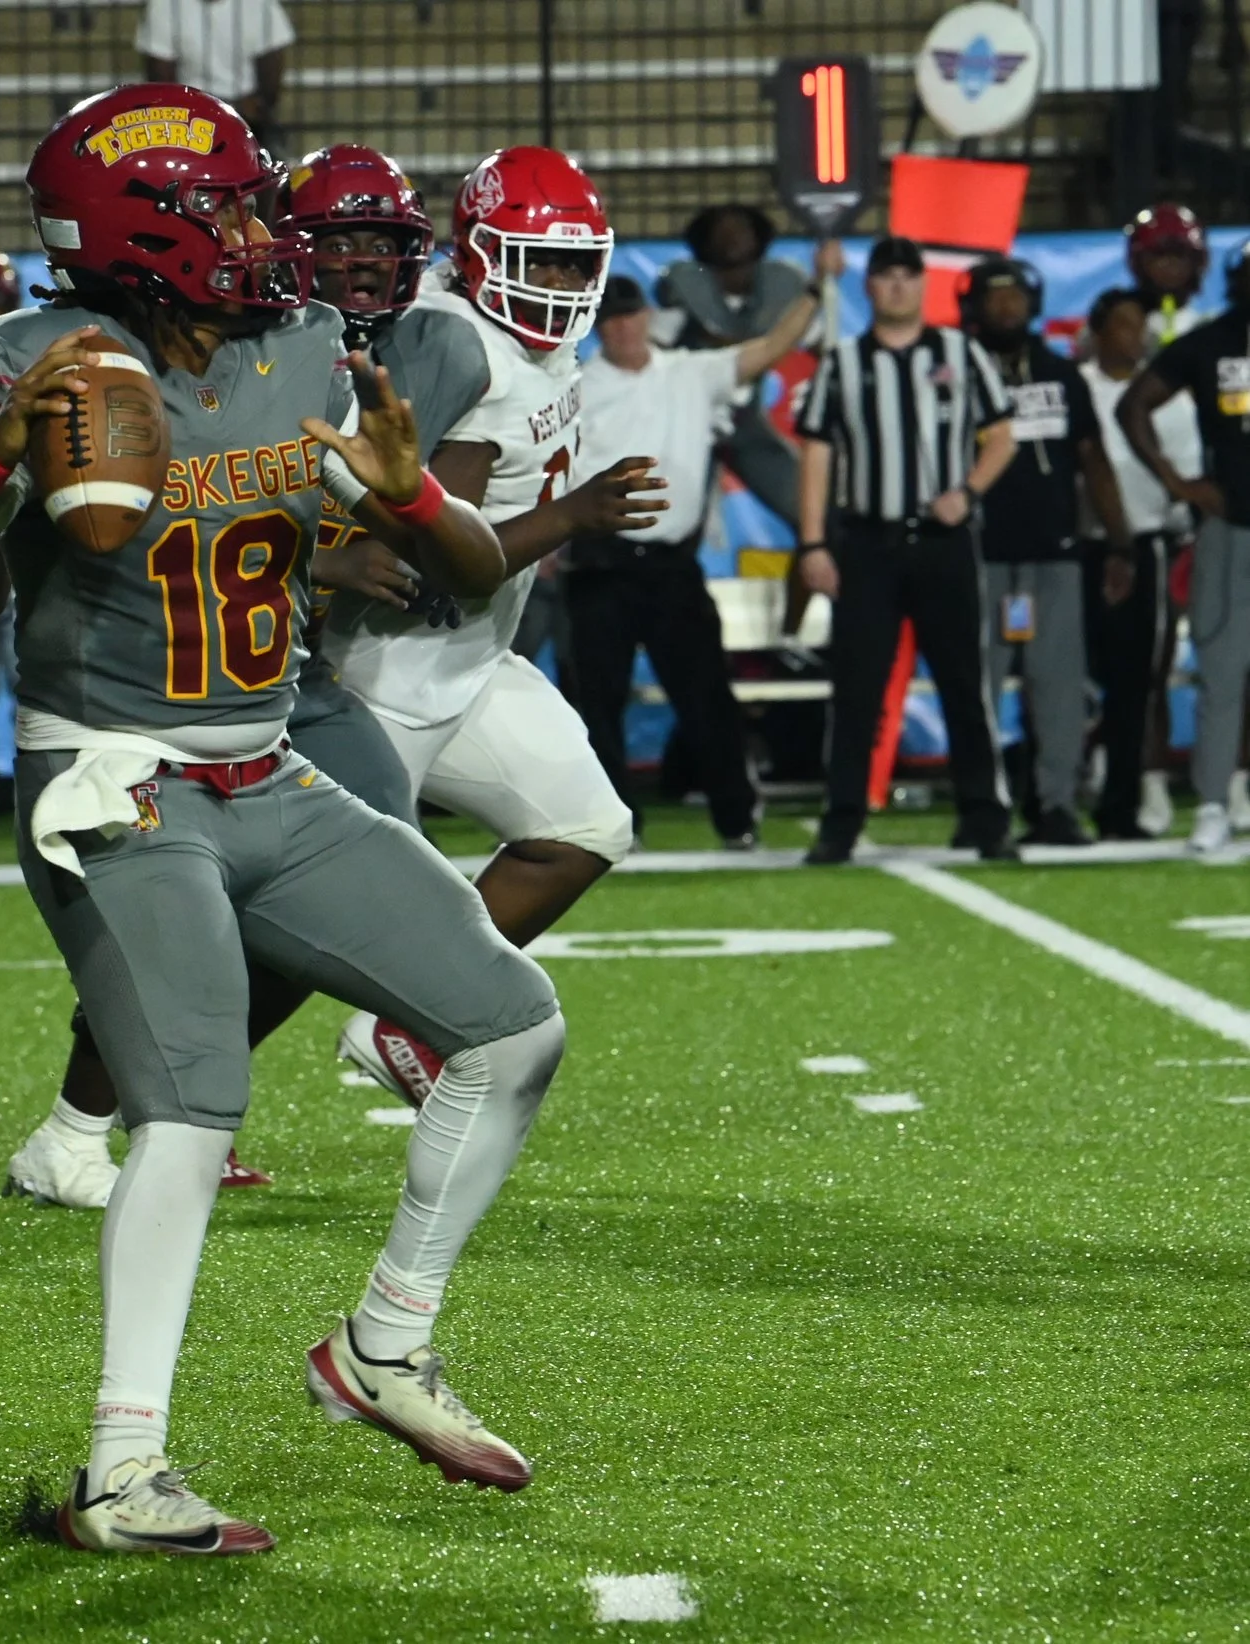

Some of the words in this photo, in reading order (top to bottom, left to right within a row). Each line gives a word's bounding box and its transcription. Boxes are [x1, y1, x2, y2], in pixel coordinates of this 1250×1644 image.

[86, 118, 217, 168] TIGERS
[111, 107, 191, 130] GOLDEN
[802, 65, 846, 184] 1
[148, 508, 302, 699] 18
